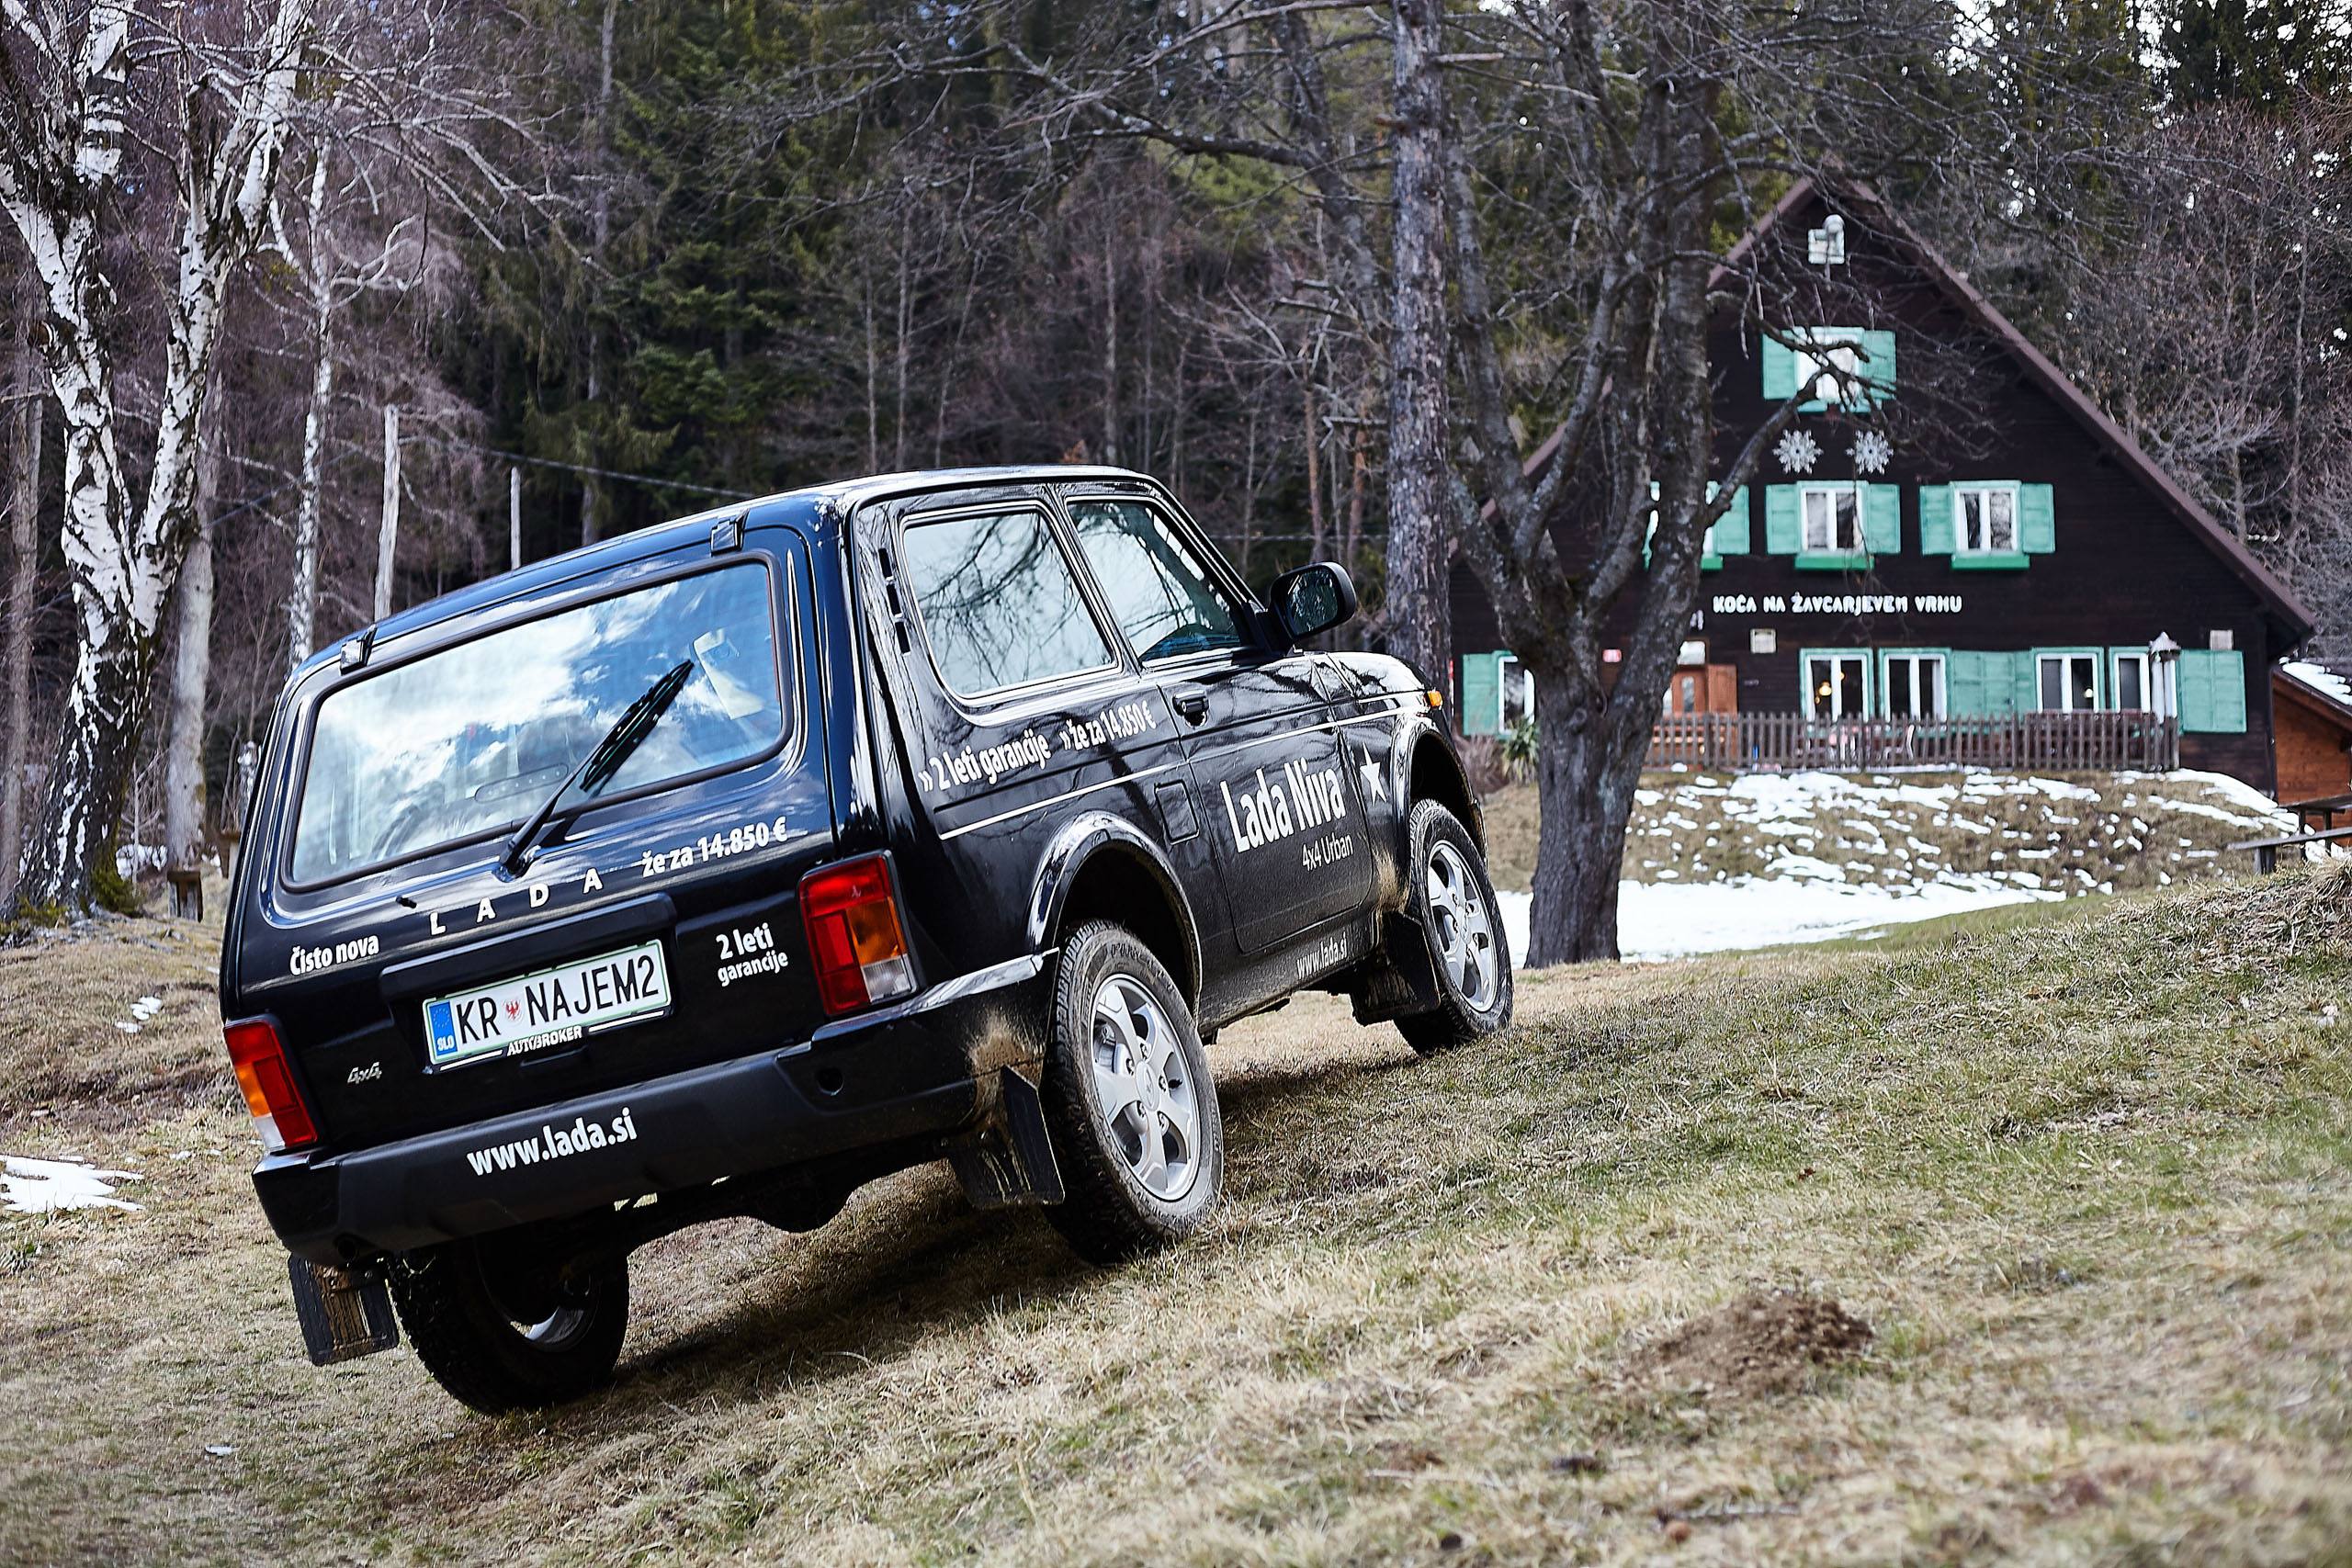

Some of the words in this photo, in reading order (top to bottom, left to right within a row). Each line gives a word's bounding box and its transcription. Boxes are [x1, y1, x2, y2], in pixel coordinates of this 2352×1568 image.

[1713, 593, 1758, 614] KOČA
[1763, 595, 1786, 614] NA
[1915, 595, 1962, 614] VRHU
[929, 757, 951, 791] 2
[943, 745, 981, 785] leti
[979, 728, 1052, 785] garancije
[1067, 719, 1091, 750] že
[1091, 723, 1107, 746] za
[1099, 704, 1148, 742] 14.850
[1141, 700, 1157, 729] €
[1220, 768, 1295, 853] Lada
[1284, 757, 1347, 831] Niva
[642, 850, 666, 878] že
[670, 846, 694, 871] za
[697, 822, 770, 862] 14.850
[773, 816, 787, 842] €
[1302, 839, 1323, 872] 4x4
[1321, 832, 1353, 865] Urban
[429, 867, 604, 936] LADA
[290, 945, 334, 976] Čisto
[335, 935, 379, 964] nova
[716, 934, 734, 960] 2
[732, 922, 775, 955] leti
[1296, 931, 1348, 980] www.lada.si
[718, 950, 789, 987] garancije
[456, 997, 502, 1044] KR
[525, 954, 659, 1027] NAJEM2
[437, 1034, 455, 1052] SLO
[347, 1061, 382, 1085] 4x4
[466, 1106, 638, 1177] www.lada.si
